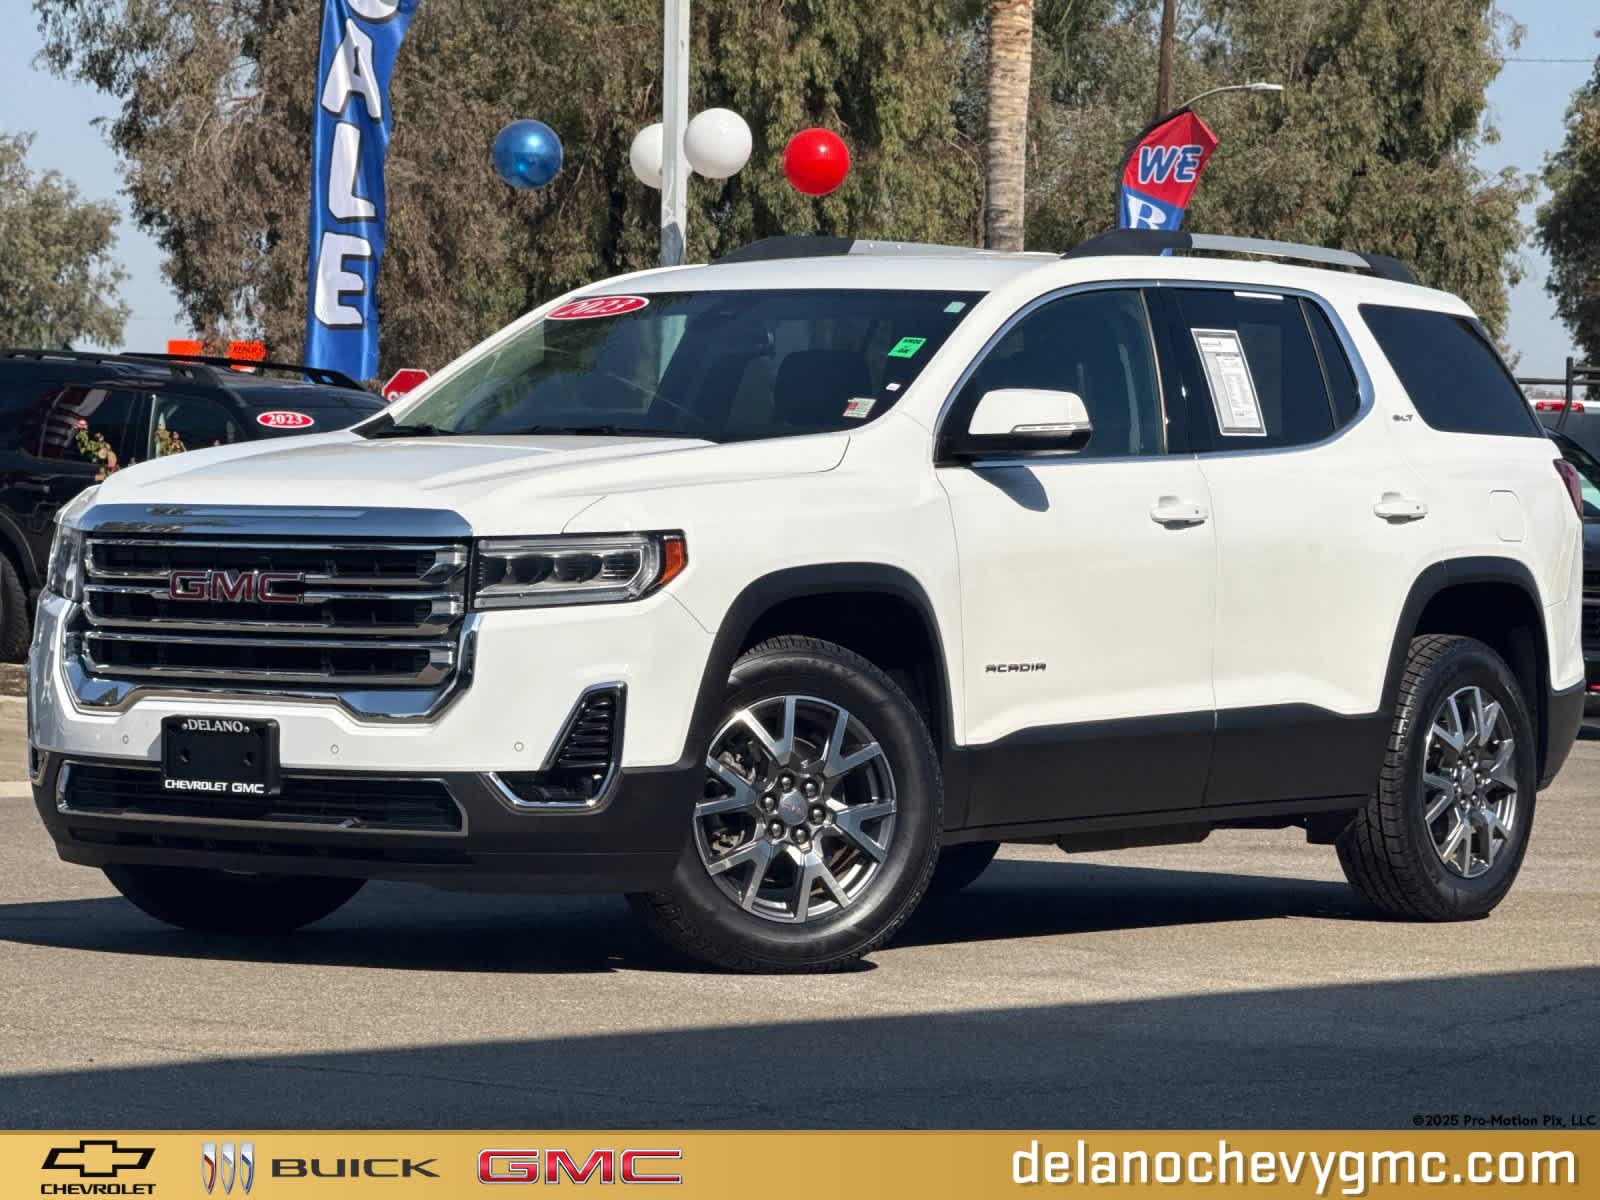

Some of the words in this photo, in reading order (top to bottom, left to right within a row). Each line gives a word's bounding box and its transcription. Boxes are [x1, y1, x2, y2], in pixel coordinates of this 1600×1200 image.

[314, 0, 398, 326] ALE
[1138, 144, 1204, 184] WE
[267, 413, 304, 425] 2023
[168, 570, 305, 604] GMC
[985, 662, 1047, 673] ACADIA
[186, 719, 244, 733] DELANO
[164, 779, 229, 791] CHEVROLET
[231, 782, 265, 794] GMC
